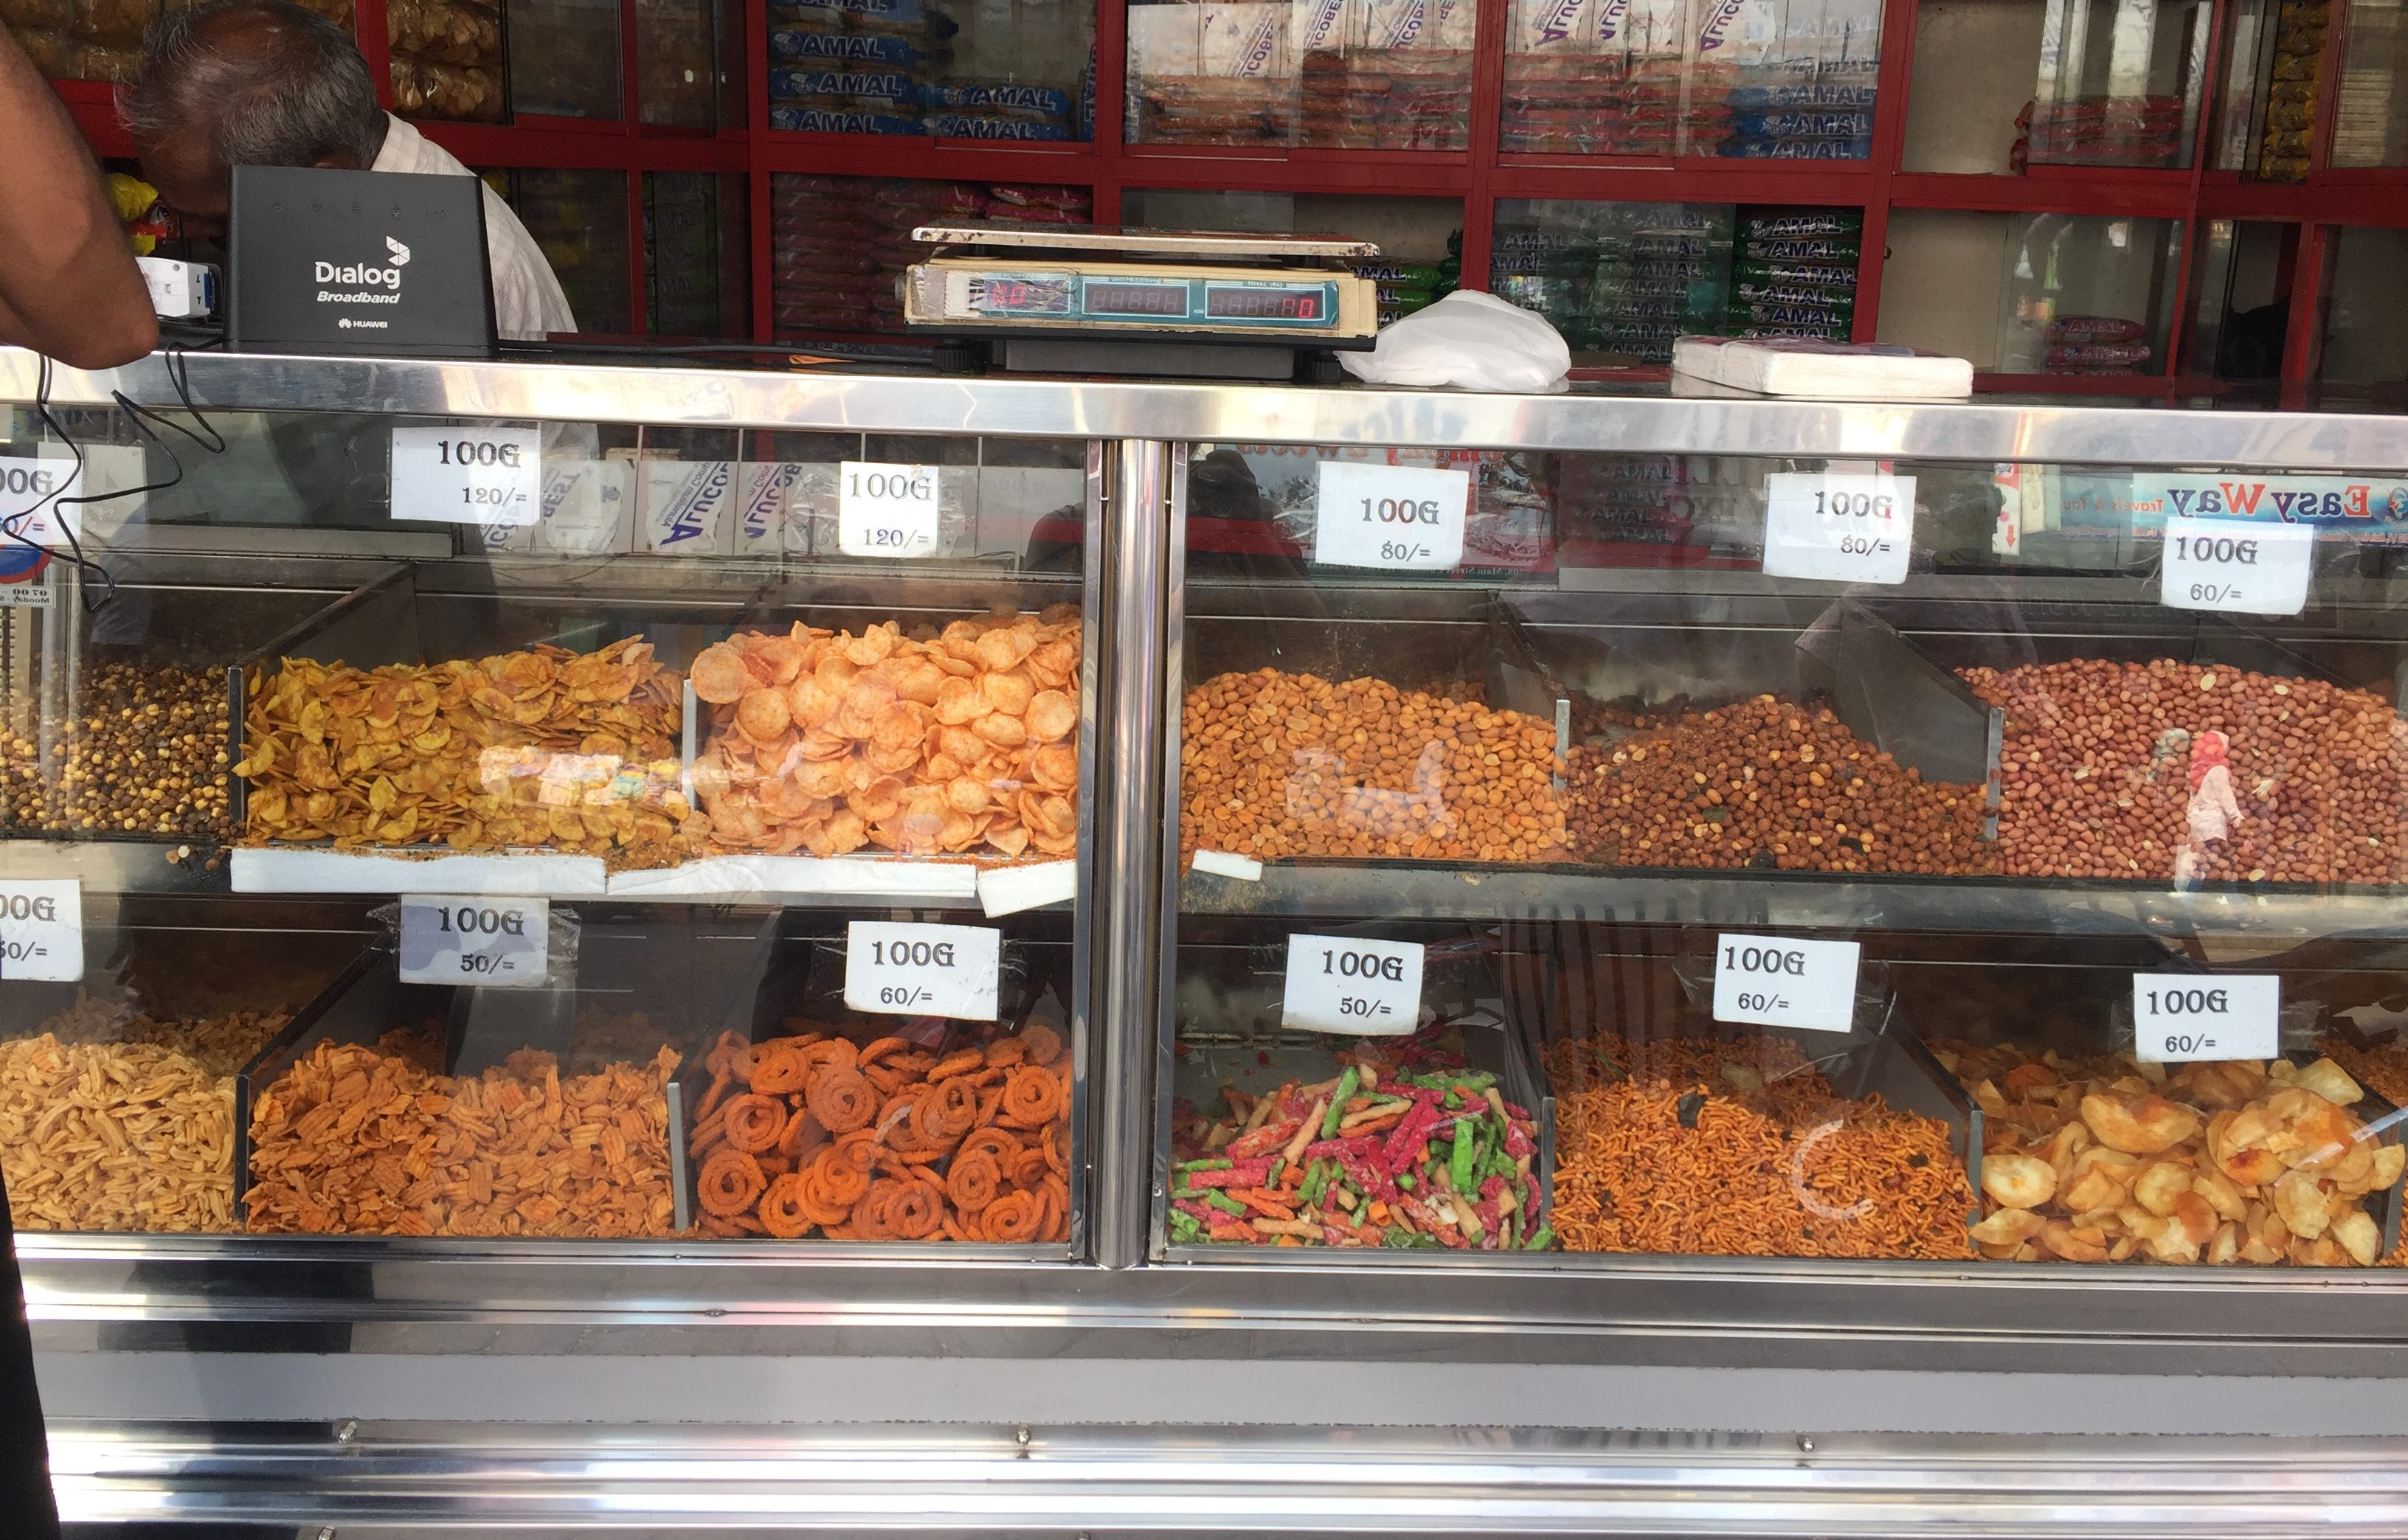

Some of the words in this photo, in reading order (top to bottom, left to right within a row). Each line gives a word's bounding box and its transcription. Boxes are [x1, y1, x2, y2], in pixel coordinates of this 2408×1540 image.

[801, 35, 885, 59] AMAL
[817, 73, 902, 97] AMAL
[1791, 85, 1875, 105] AMAL
[971, 86, 1056, 111] AMAL
[799, 111, 882, 133] AMAL
[951, 118, 1037, 140] AMAL
[1791, 114, 1872, 135] AMAL
[1772, 216, 1843, 236] AMAL
[1769, 240, 1839, 259] AMAL
[315, 262, 401, 290] Dialog
[1791, 266, 1858, 286] AMAL
[316, 291, 401, 304] Broadband
[1762, 285, 1831, 307] AMAL
[1772, 306, 1842, 327] AMAL
[438, 440, 522, 468] 100G
[463, 487, 527, 507] 120/=
[849, 473, 933, 501] 100G
[1360, 498, 1440, 525] 100G
[1815, 490, 1894, 520] 100G
[863, 528, 930, 549] 120/=
[1841, 534, 1891, 556] 80/=
[1380, 541, 1431, 562] 80/=
[2177, 536, 2259, 566] 100G
[2190, 583, 2243, 604] 60/=
[438, 906, 525, 936] 100G
[460, 953, 516, 975] 50/=
[872, 940, 956, 967] 100G
[1725, 946, 1805, 977] 100G
[1323, 949, 1404, 982] 100G
[880, 986, 933, 1006] 60/=
[1738, 993, 1790, 1013] 60/=
[2147, 989, 2229, 1016] 100G
[1340, 996, 1392, 1019] 50/=
[2165, 1033, 2217, 1055] 60/=
